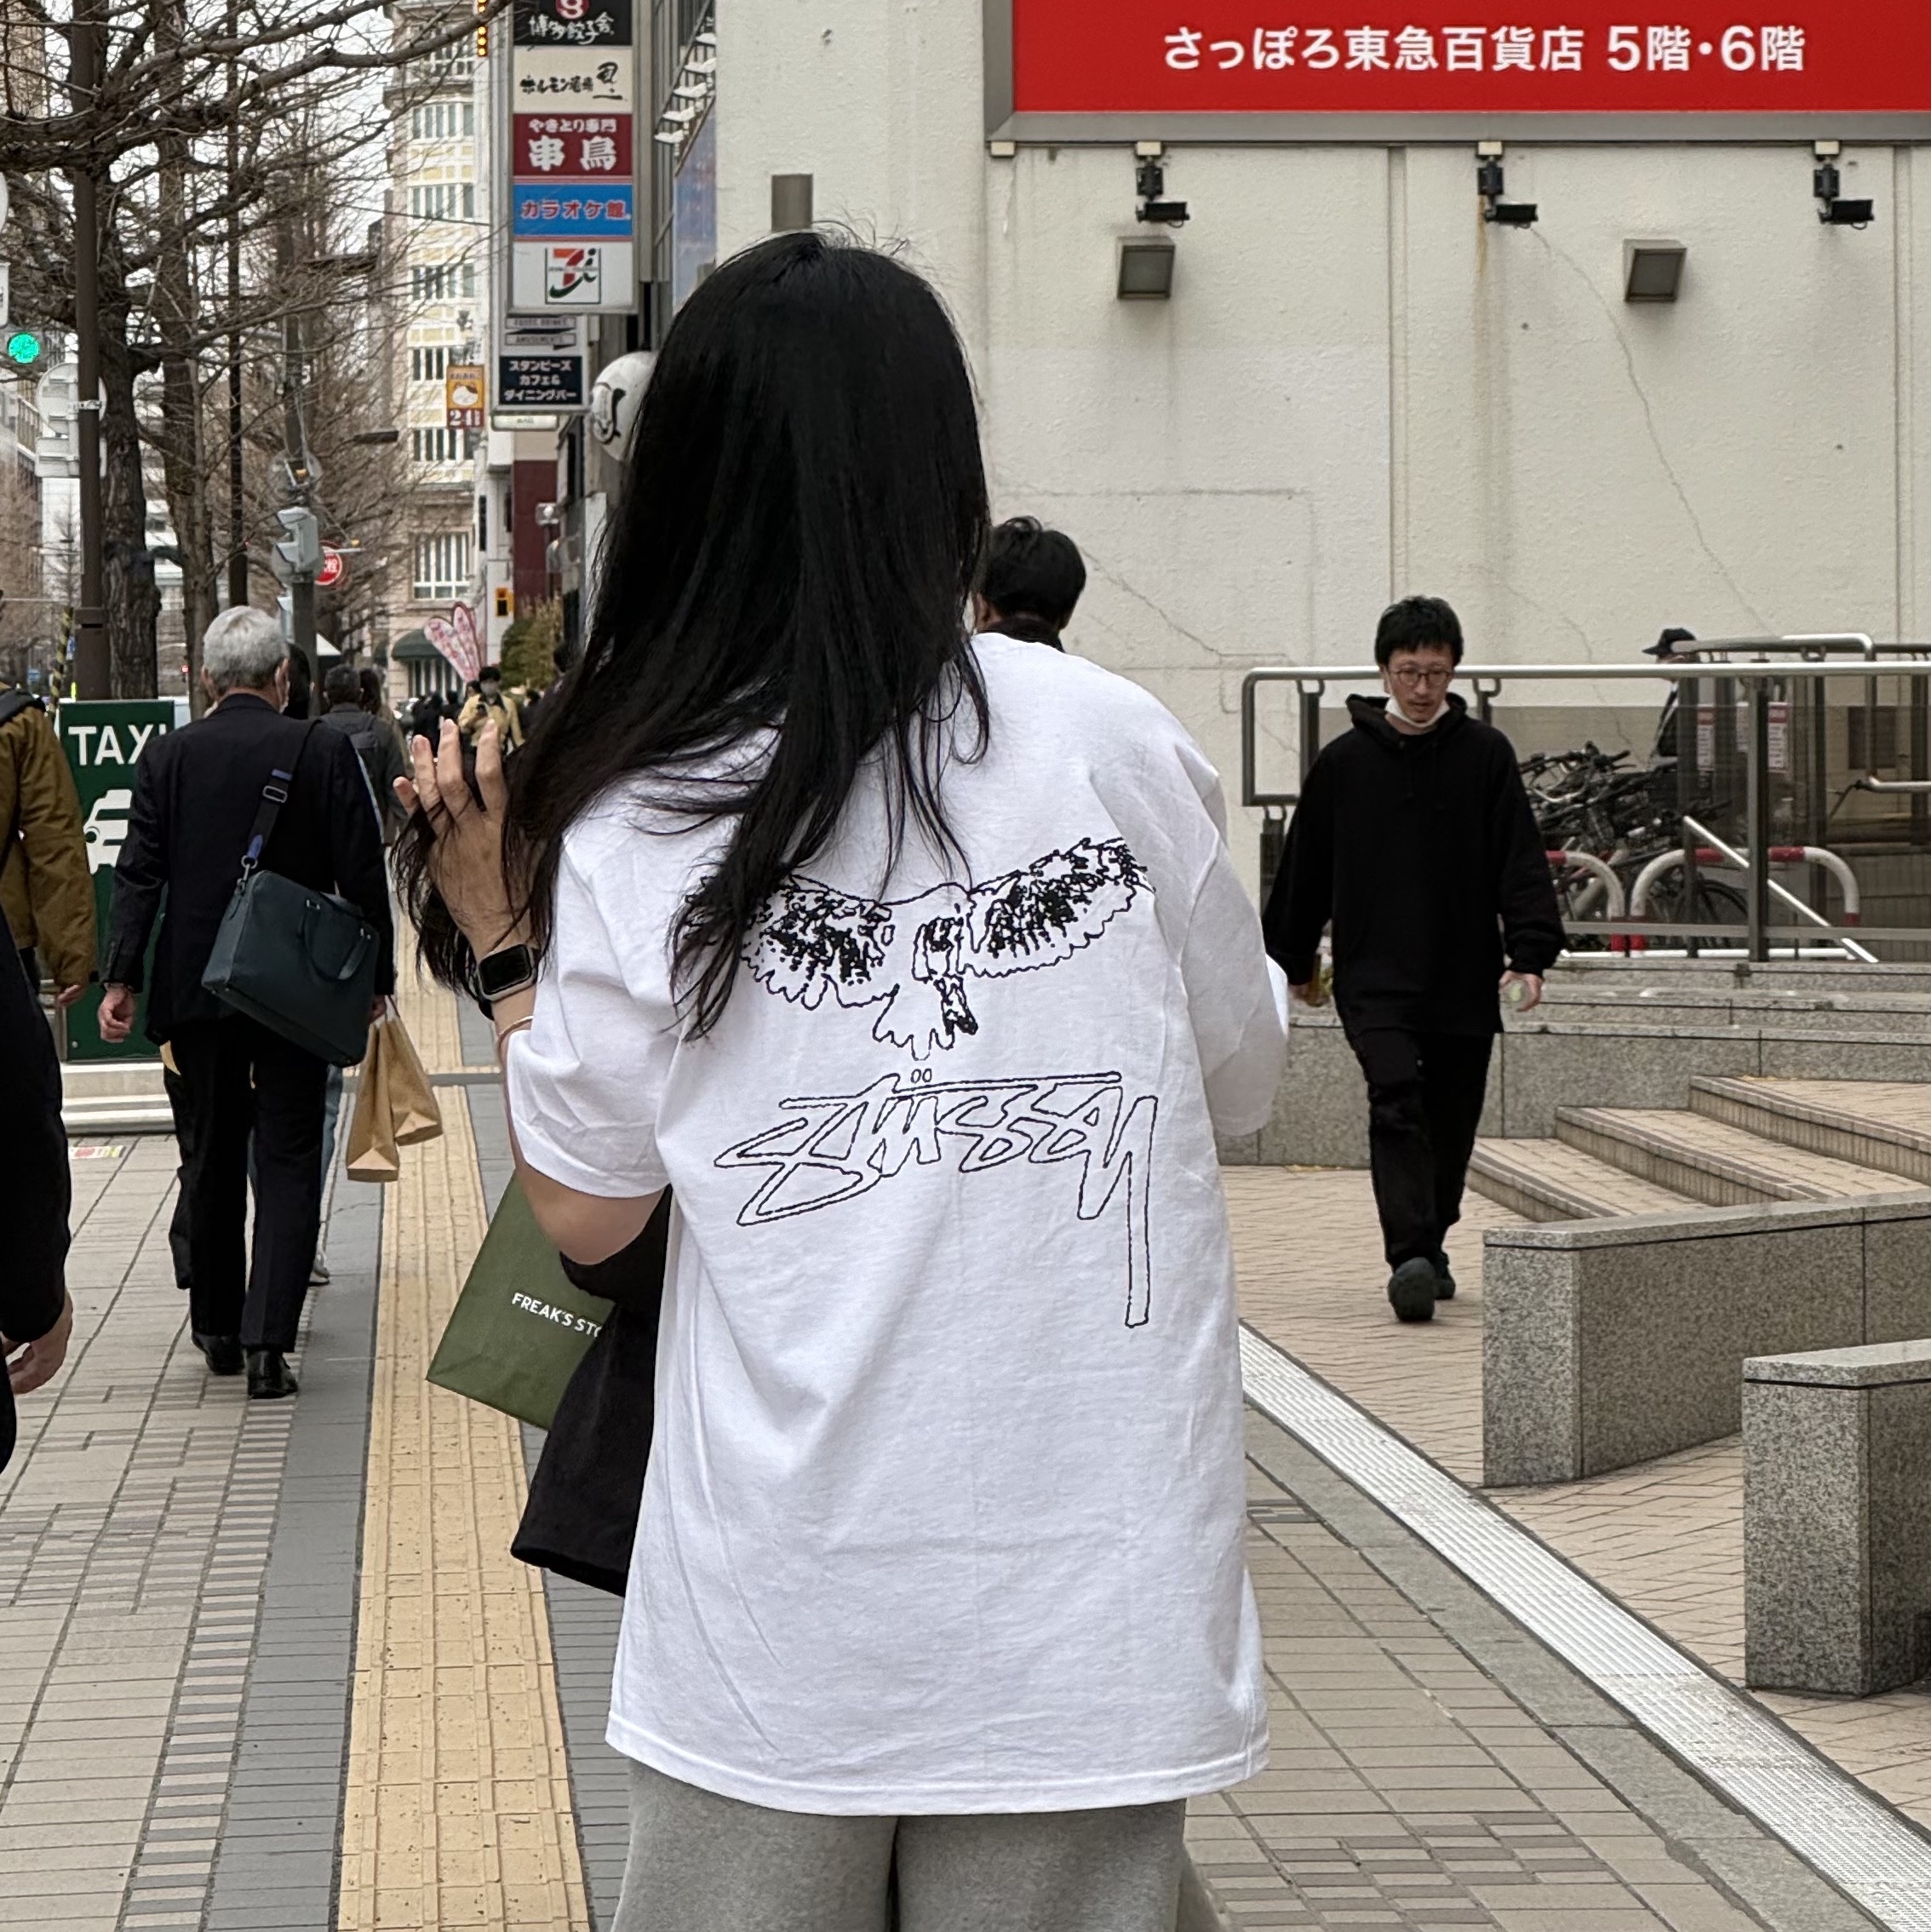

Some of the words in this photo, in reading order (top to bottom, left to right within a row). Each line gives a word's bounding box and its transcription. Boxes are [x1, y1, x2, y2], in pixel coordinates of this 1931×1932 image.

[1164, 25, 1584, 72] さっぽろ東急百貨店
[1607, 25, 1806, 72] 5階・6階
[529, 118, 616, 133] やきとり専門
[528, 135, 616, 172] 串鳥
[520, 199, 627, 221] カラオケ館
[504, 389, 576, 401] ダイニングバー
[68, 723, 168, 766] TAX
[511, 1292, 575, 1327] FREAK'S
